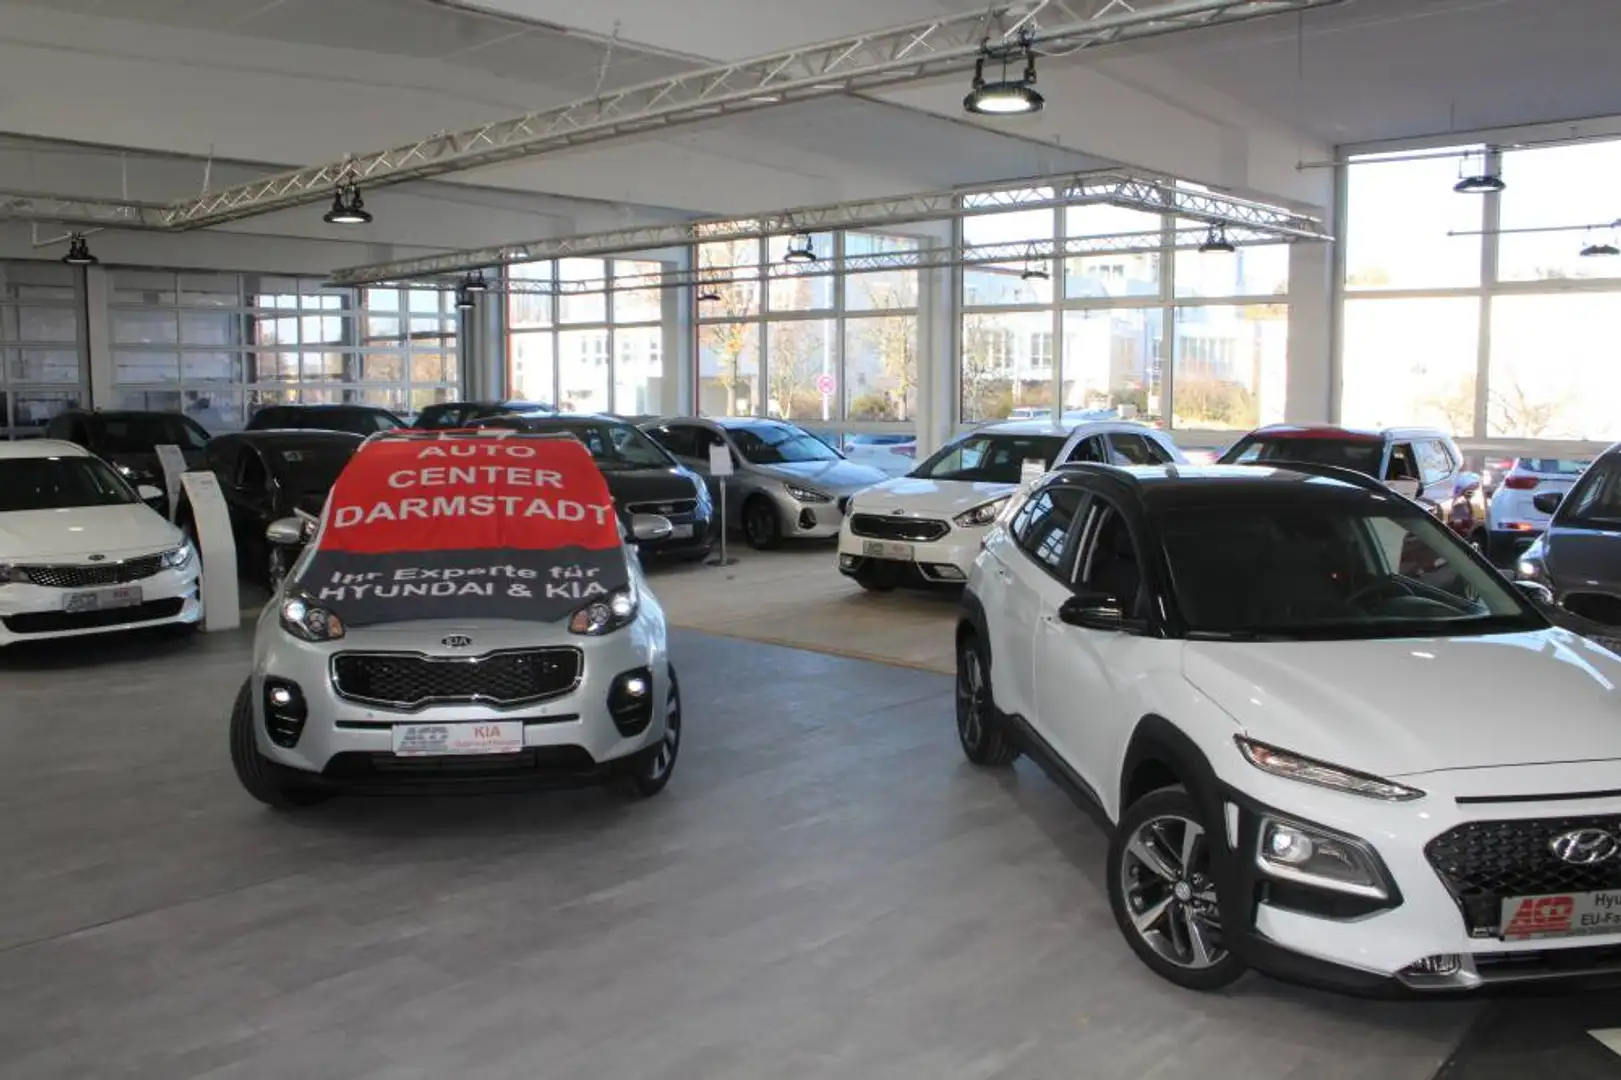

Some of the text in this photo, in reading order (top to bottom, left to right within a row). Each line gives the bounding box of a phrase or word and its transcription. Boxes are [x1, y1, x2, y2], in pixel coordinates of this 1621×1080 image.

[416, 444, 537, 460] AUTO
[387, 465, 565, 489] CENTER
[333, 496, 612, 529] DARMSTADT
[318, 580, 609, 601] HYUNDAI & KIA
[473, 725, 501, 739] KIA
